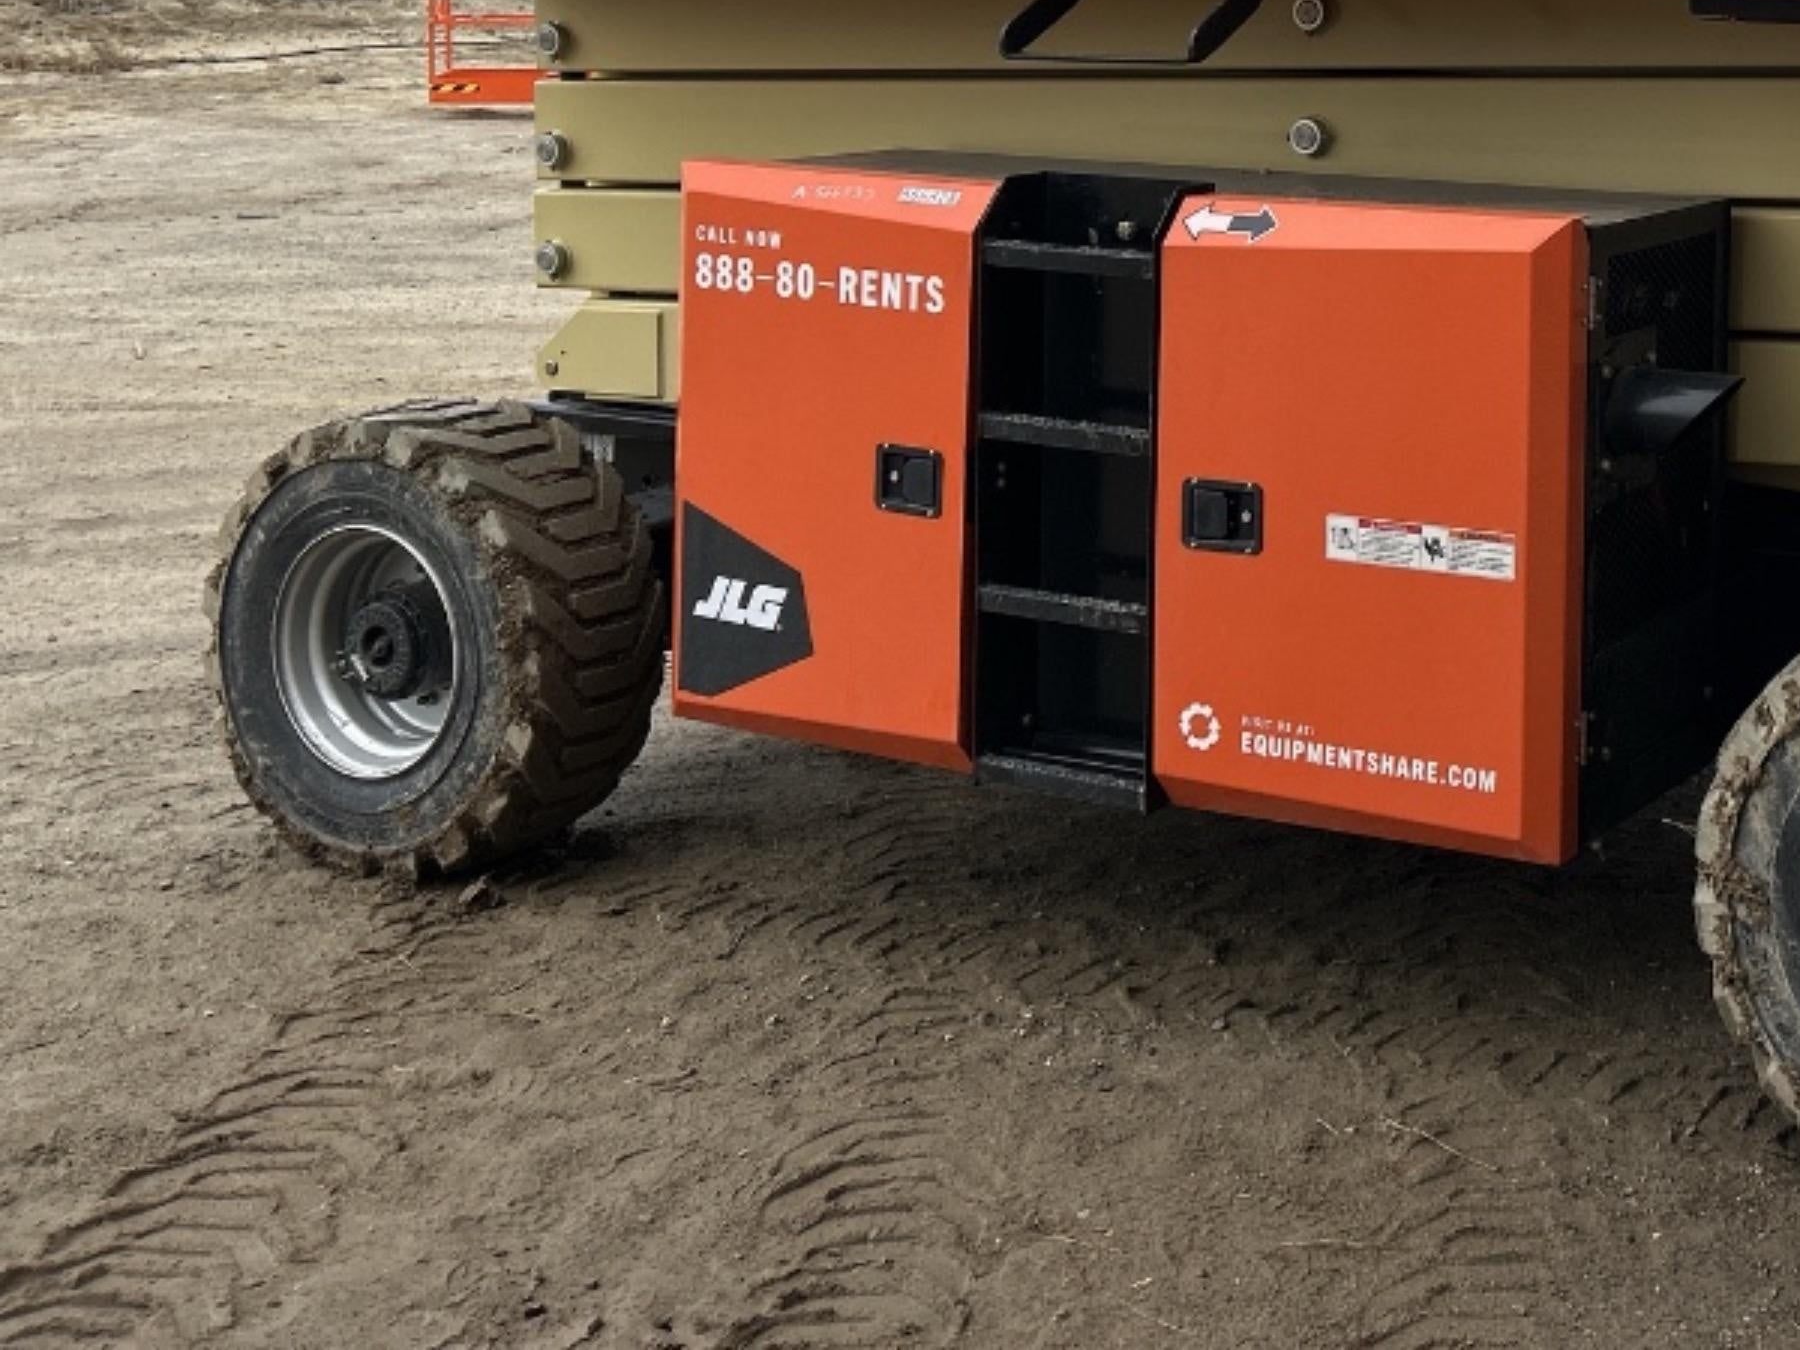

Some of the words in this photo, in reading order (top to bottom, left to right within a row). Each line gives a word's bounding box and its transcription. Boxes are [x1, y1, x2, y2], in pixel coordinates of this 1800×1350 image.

[695, 224, 737, 245] CALL
[745, 230, 783, 250] NOW
[694, 252, 945, 314] 888-80-RENTS
[692, 574, 788, 632] JLG
[1240, 730, 1498, 794] EQUIPMENTSHARE.COM
